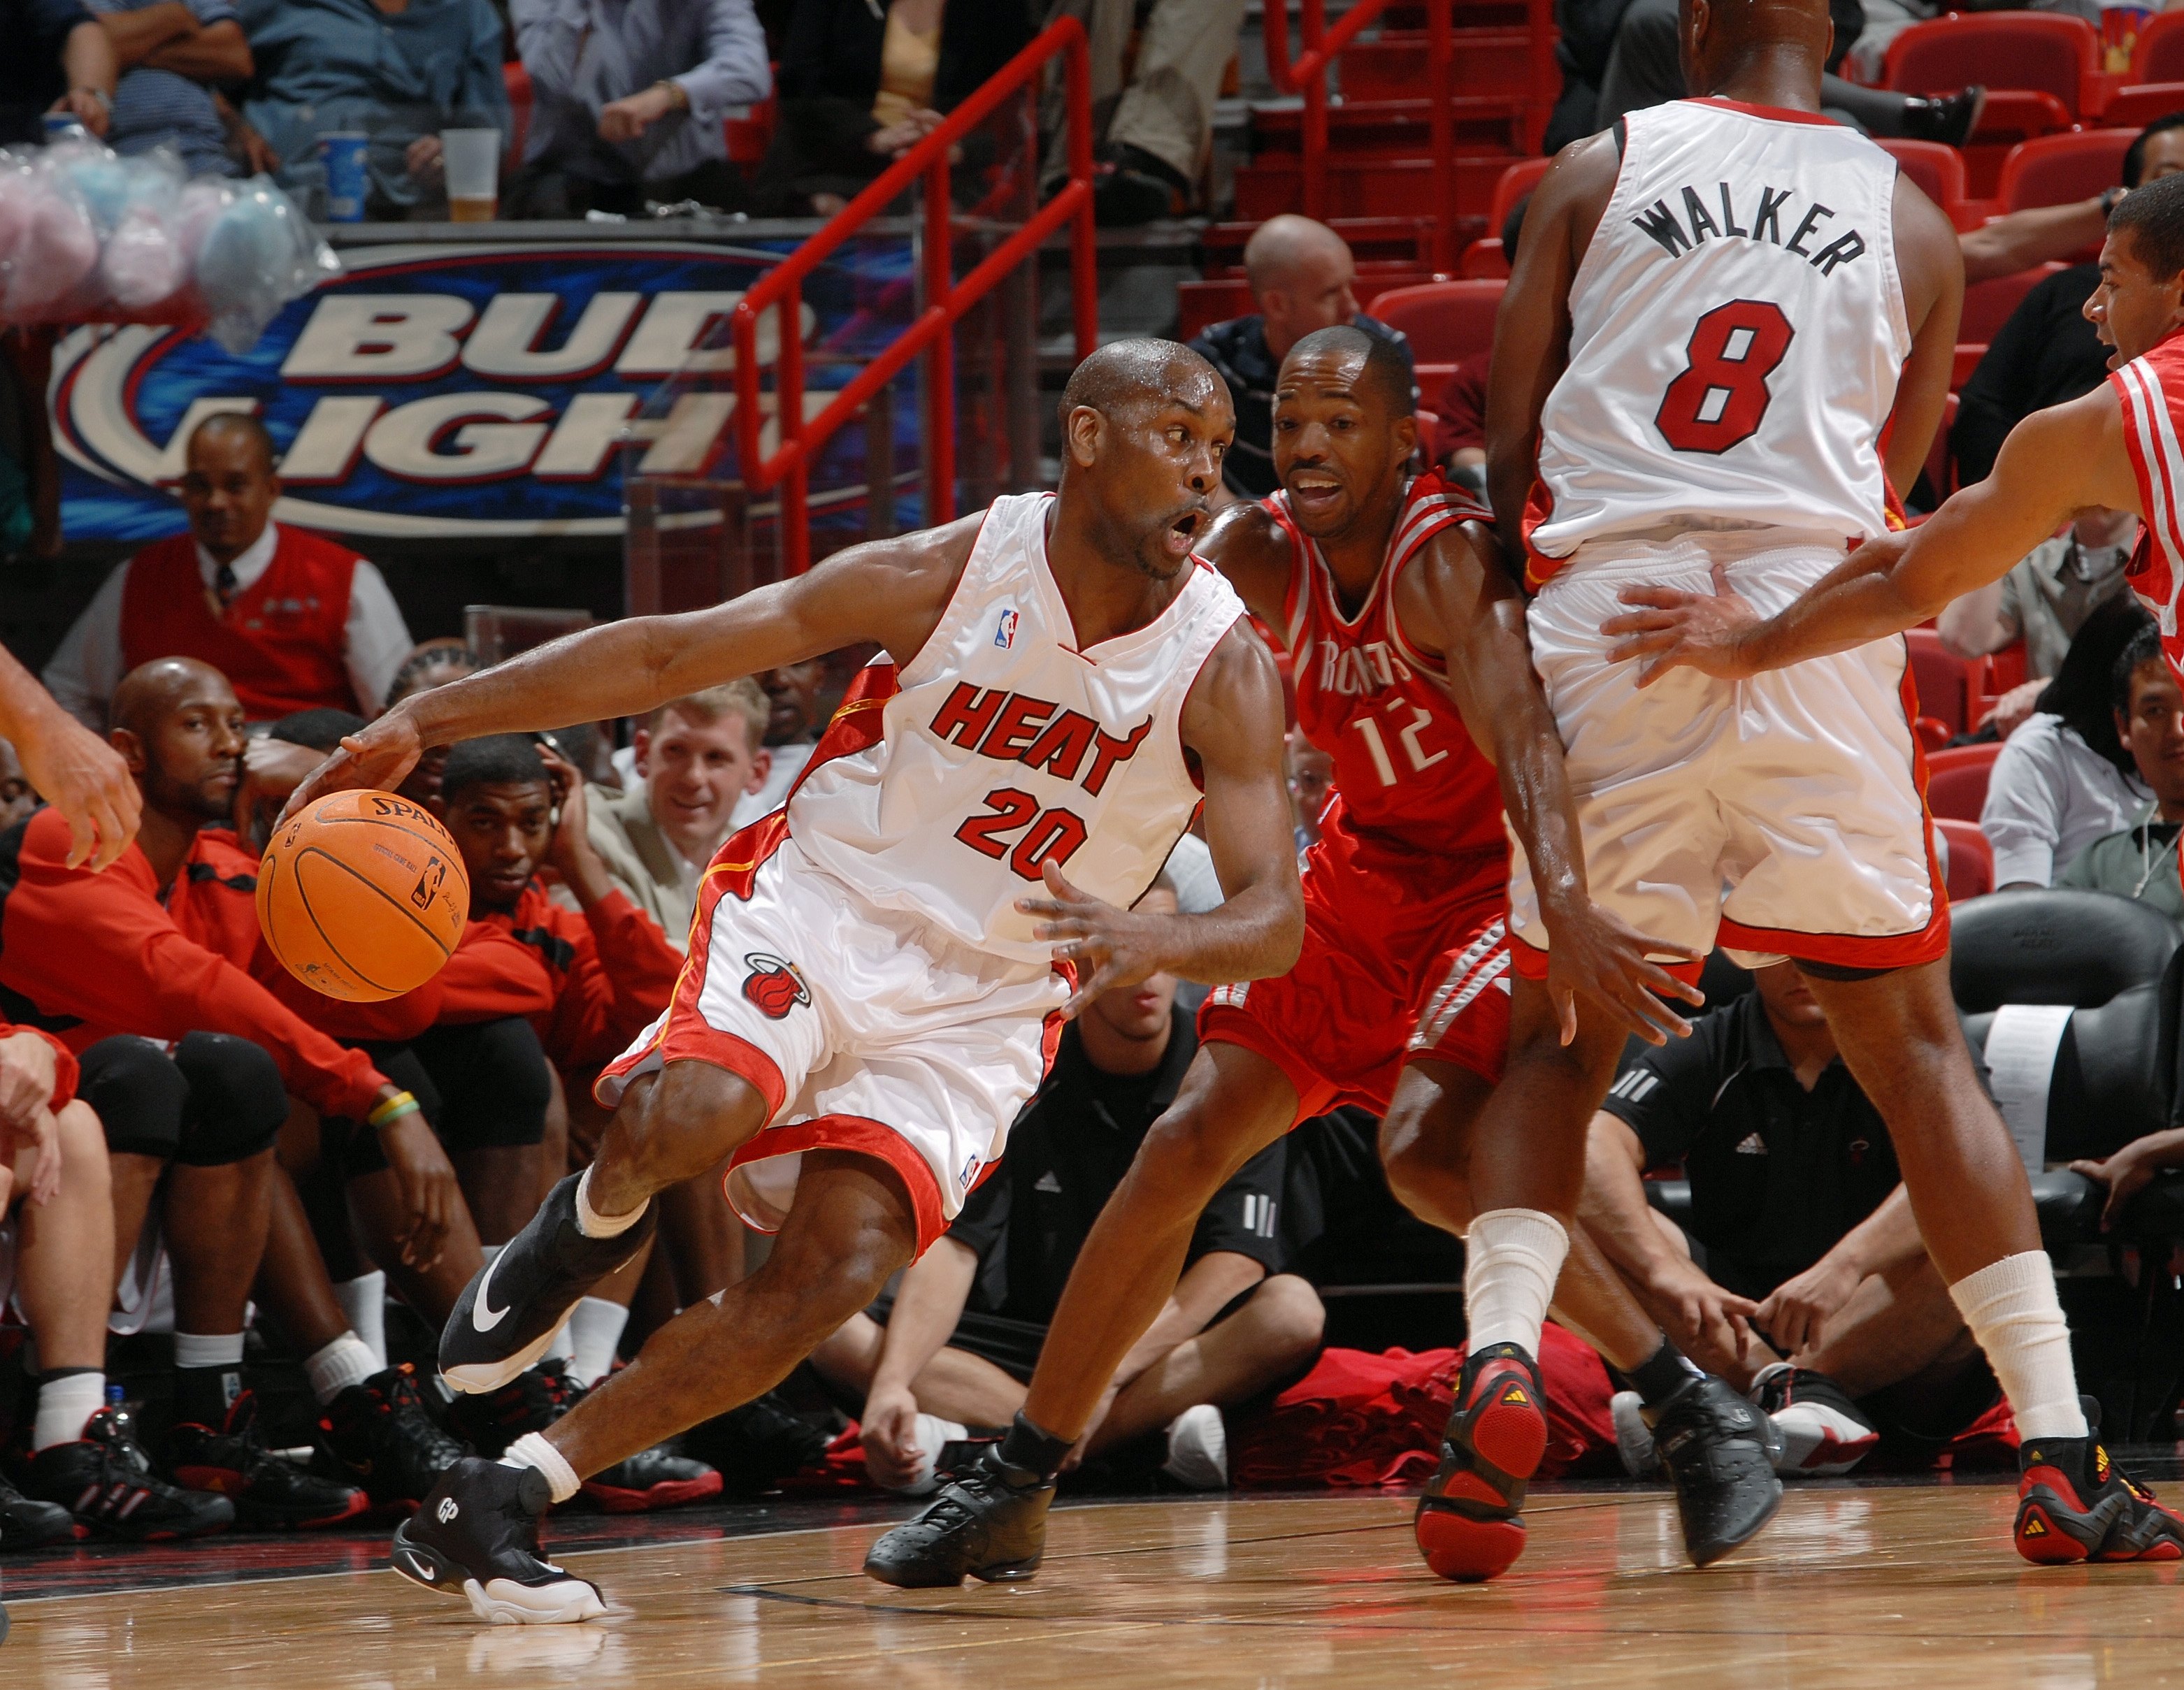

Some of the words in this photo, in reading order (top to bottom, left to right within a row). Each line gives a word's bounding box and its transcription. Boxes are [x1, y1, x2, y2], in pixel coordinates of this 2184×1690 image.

[1632, 182, 1866, 277] WALKER
[280, 289, 819, 383] BUD
[1654, 298, 1796, 454] 8
[929, 681, 1153, 798] HEAT
[1353, 697, 1449, 787] 12
[394, 853, 408, 866] GAME
[406, 861, 417, 874] BALL
[954, 787, 1089, 882] 20
[439, 1497, 459, 1524] GP
